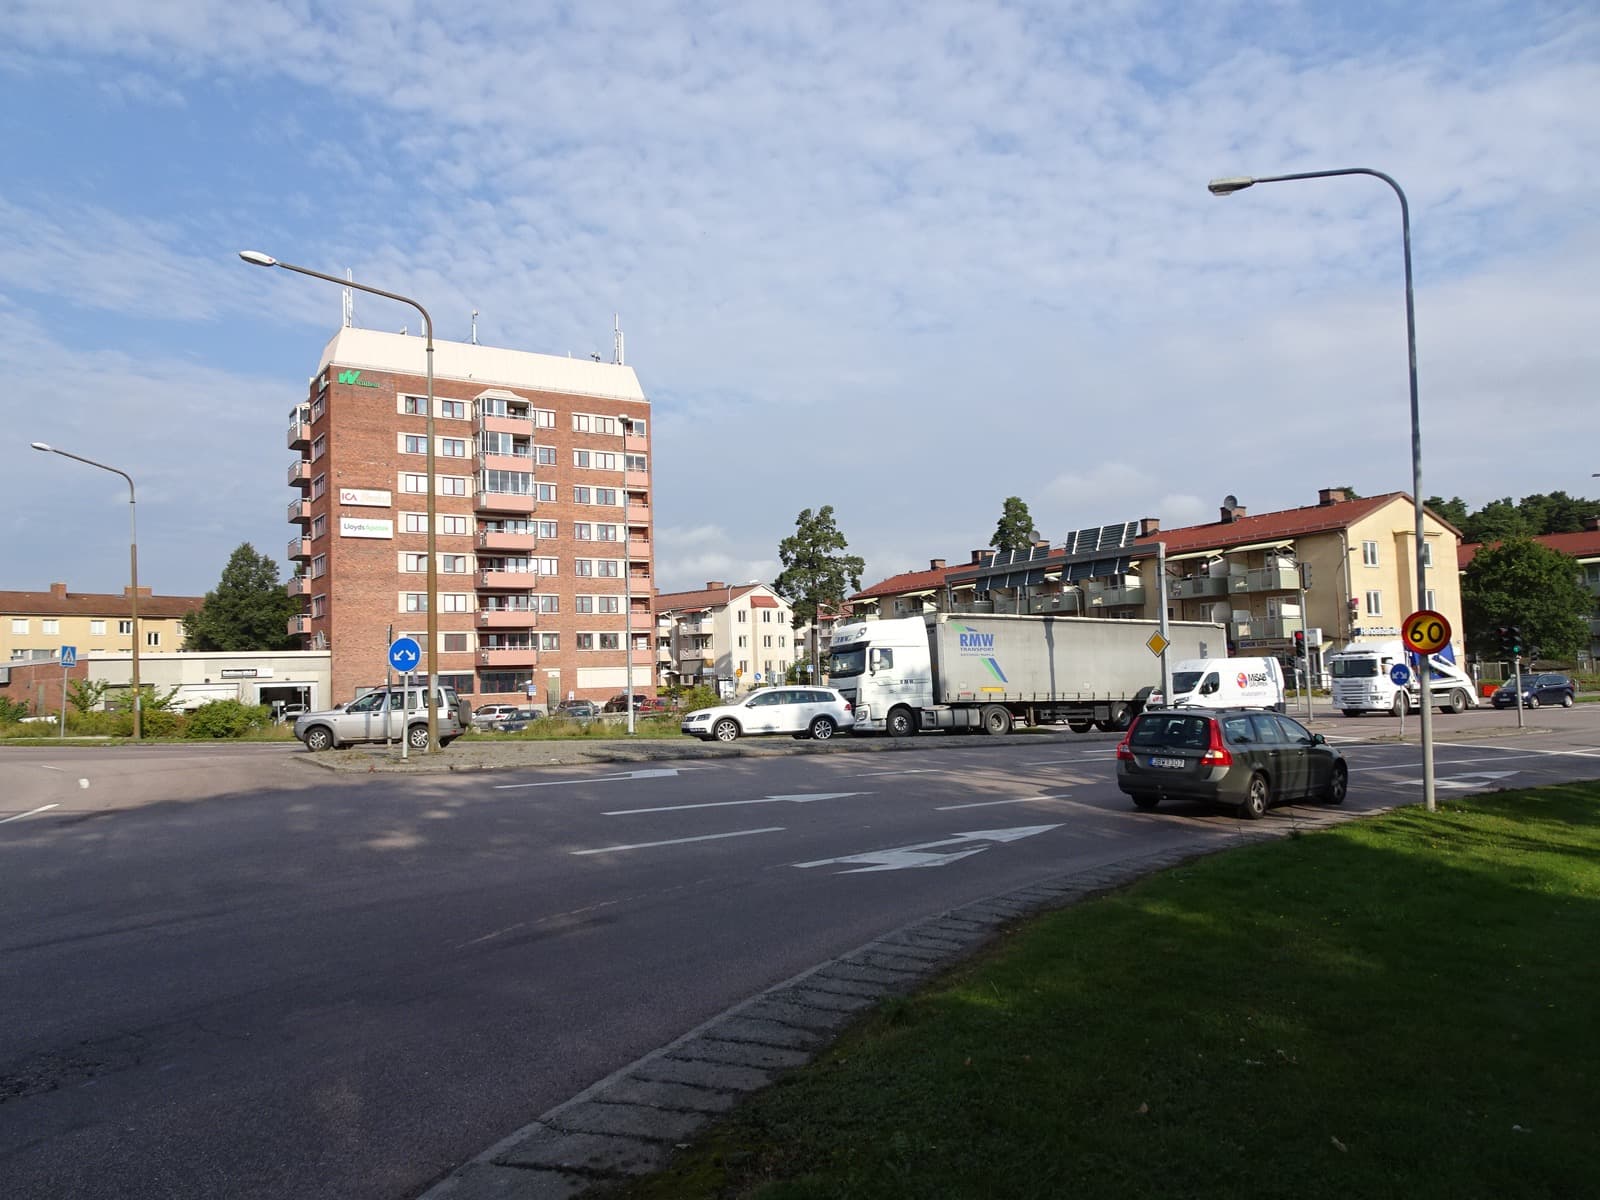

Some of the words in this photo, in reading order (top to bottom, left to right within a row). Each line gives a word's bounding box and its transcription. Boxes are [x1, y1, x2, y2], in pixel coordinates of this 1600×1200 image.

[341, 492, 358, 501] ICA
[1410, 621, 1444, 643] 60
[959, 633, 994, 647] RMW
